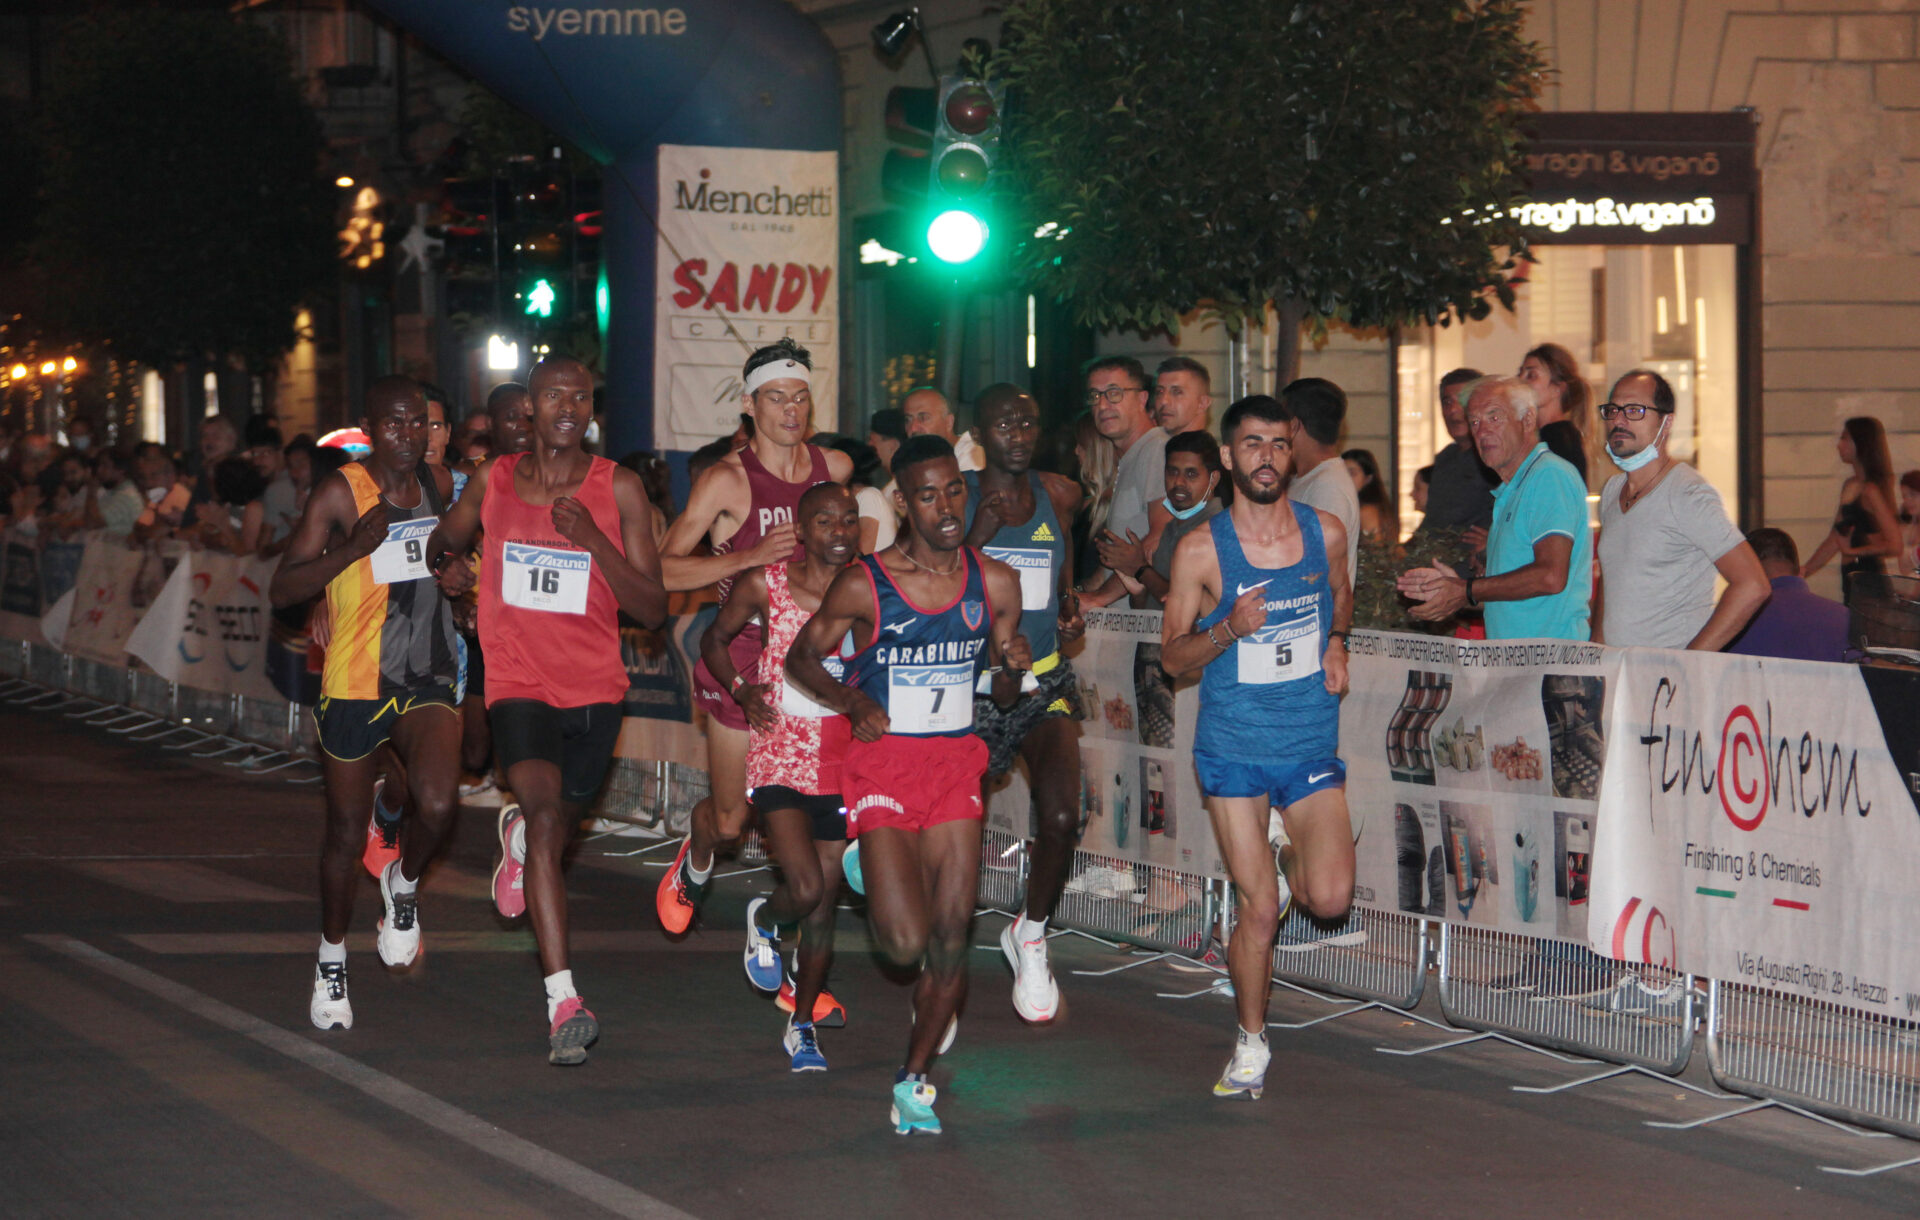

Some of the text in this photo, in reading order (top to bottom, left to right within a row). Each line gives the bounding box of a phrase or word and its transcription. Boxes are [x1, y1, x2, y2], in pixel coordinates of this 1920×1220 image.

[507, 6, 687, 41] syemme
[675, 178, 833, 217] Menchetti
[672, 258, 832, 315] SANDY
[404, 538, 423, 564] 9
[1031, 534, 1055, 542] adidas
[527, 566, 560, 595] 16
[1275, 642, 1293, 667] 5
[1457, 645, 1479, 667] PER
[930, 687, 946, 714] 7
[1685, 842, 1822, 888] Finishing & Chemicals
[1737, 951, 1754, 976] Via
[1757, 955, 1800, 986] Augusto
[1852, 975, 1888, 1004] Arezzo
